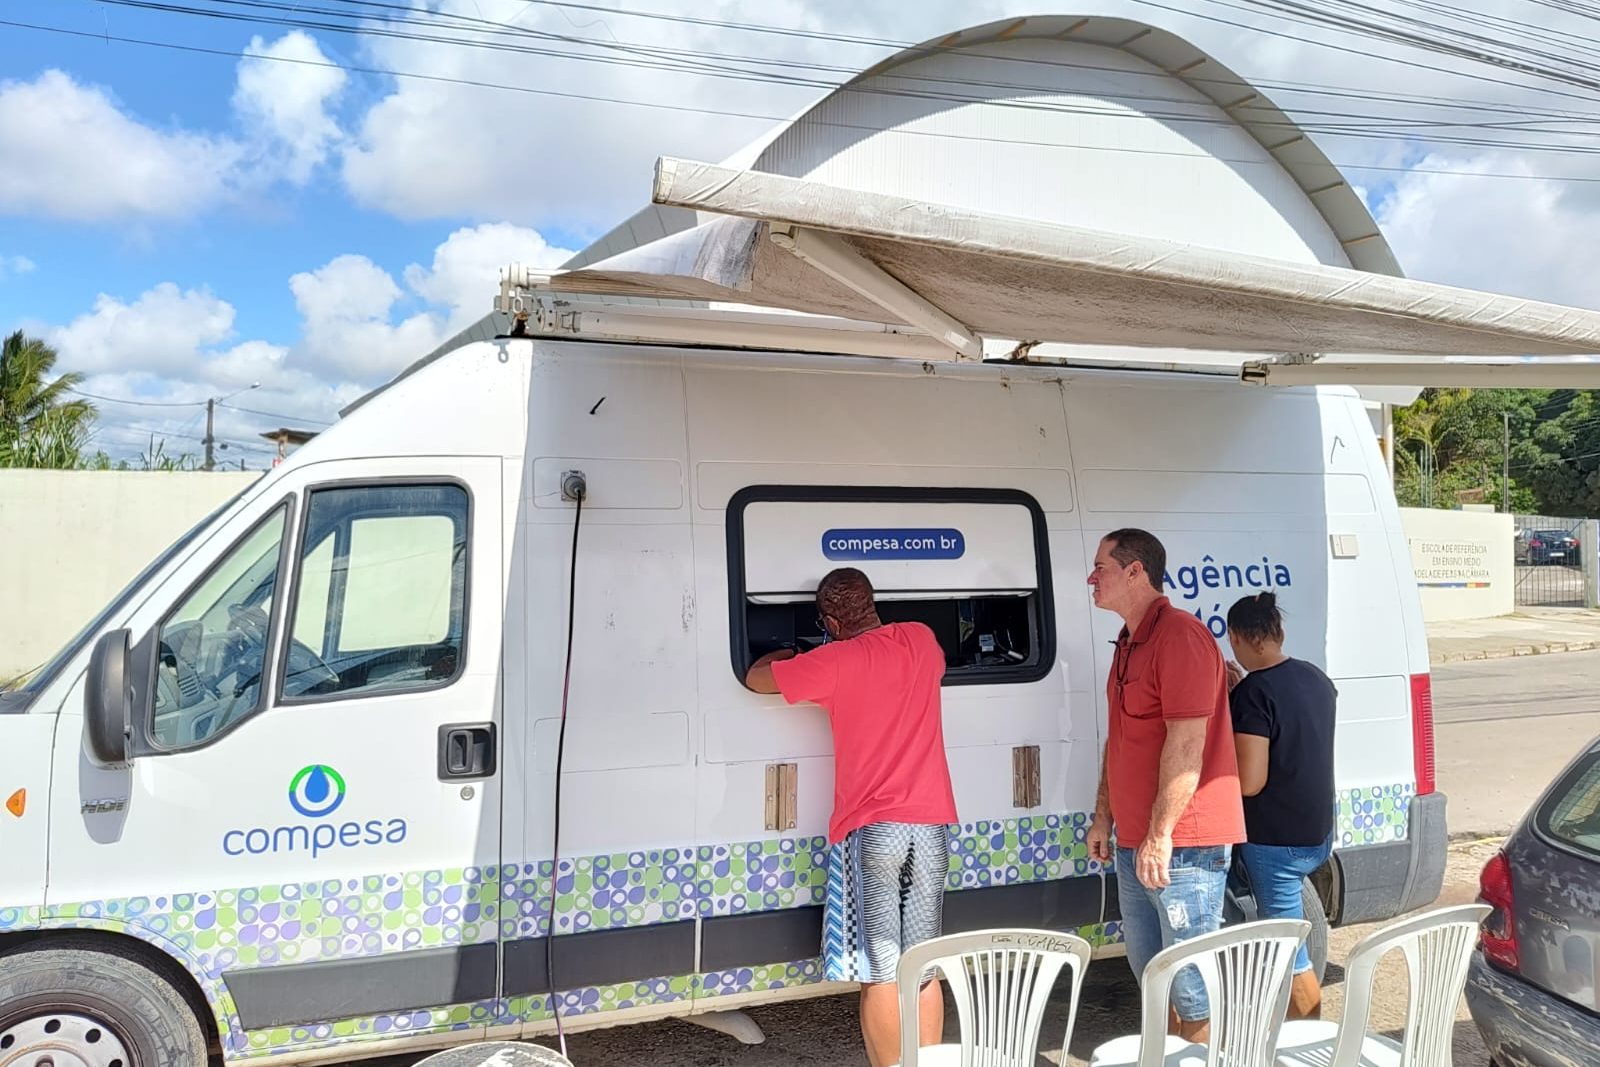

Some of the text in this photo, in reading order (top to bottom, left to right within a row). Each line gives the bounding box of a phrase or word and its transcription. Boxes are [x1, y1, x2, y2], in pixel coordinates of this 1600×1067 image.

[1421, 543, 1445, 554] ESCOLA
[1445, 543, 1454, 554] DE
[223, 818, 407, 859] compesa
